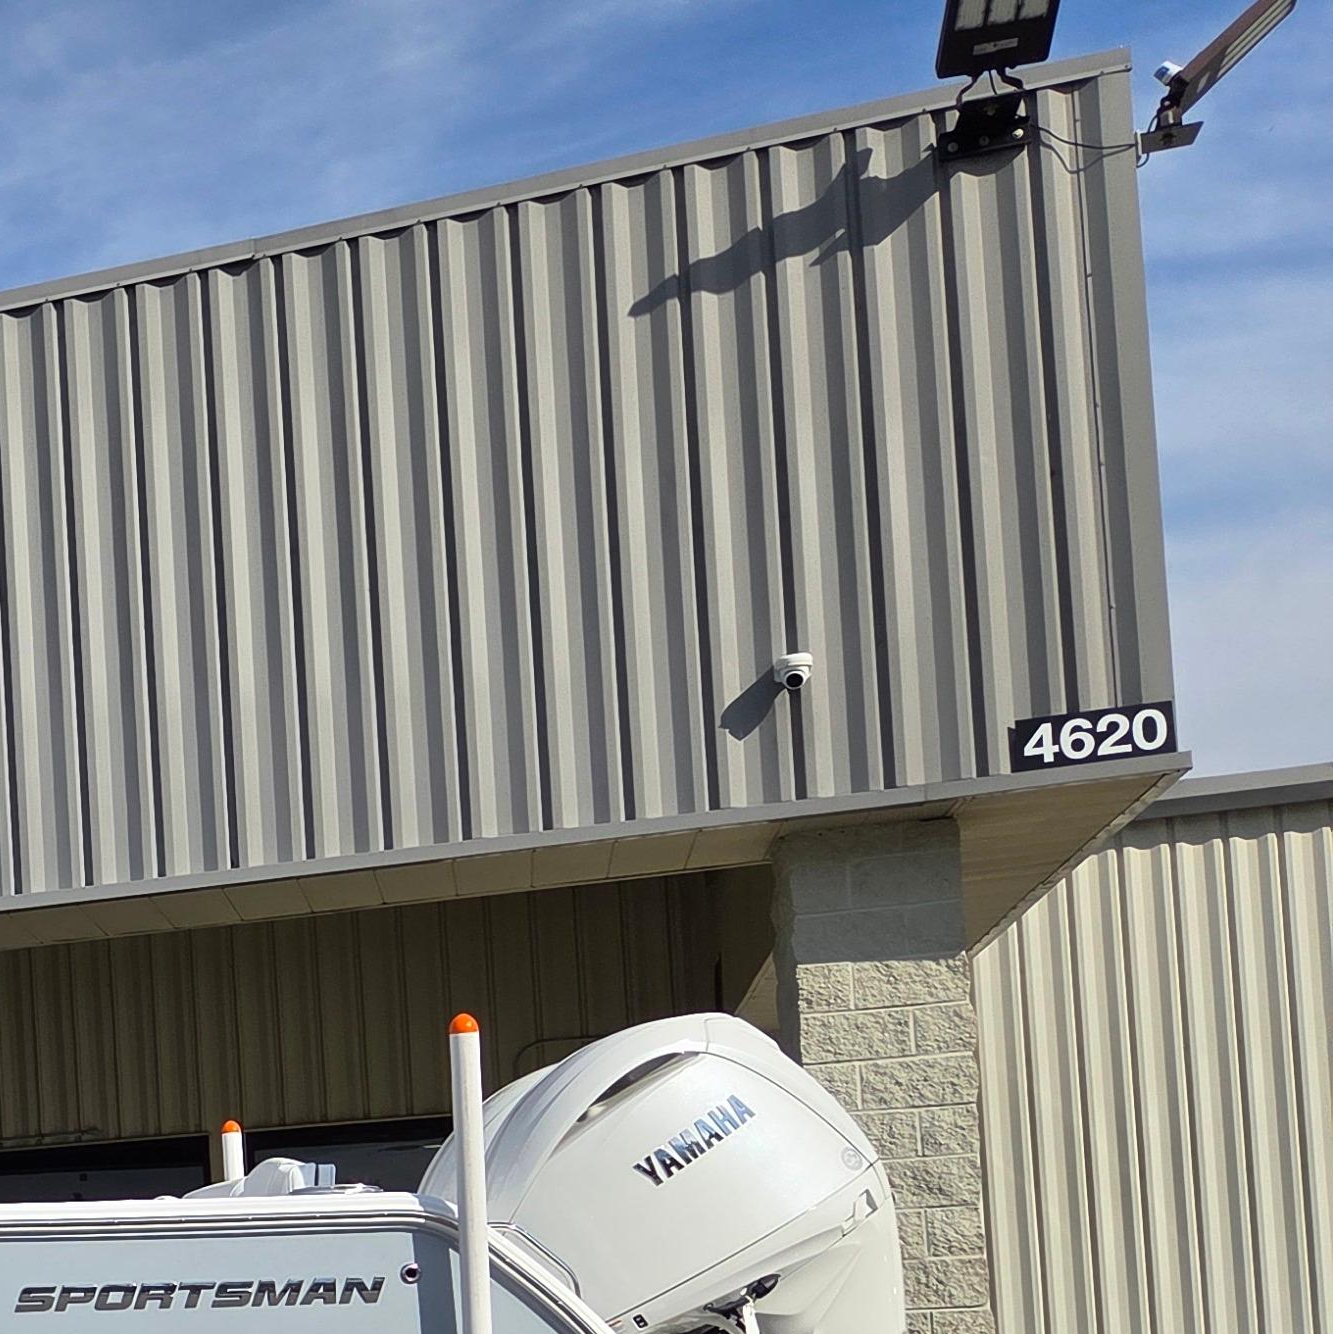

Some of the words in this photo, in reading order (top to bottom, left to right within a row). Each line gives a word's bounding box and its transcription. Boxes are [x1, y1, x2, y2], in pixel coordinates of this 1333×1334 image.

[1023, 708, 1168, 763] 4620
[633, 1094, 756, 1187] YAMAHA
[14, 1276, 386, 1313] SPORTSMAN
